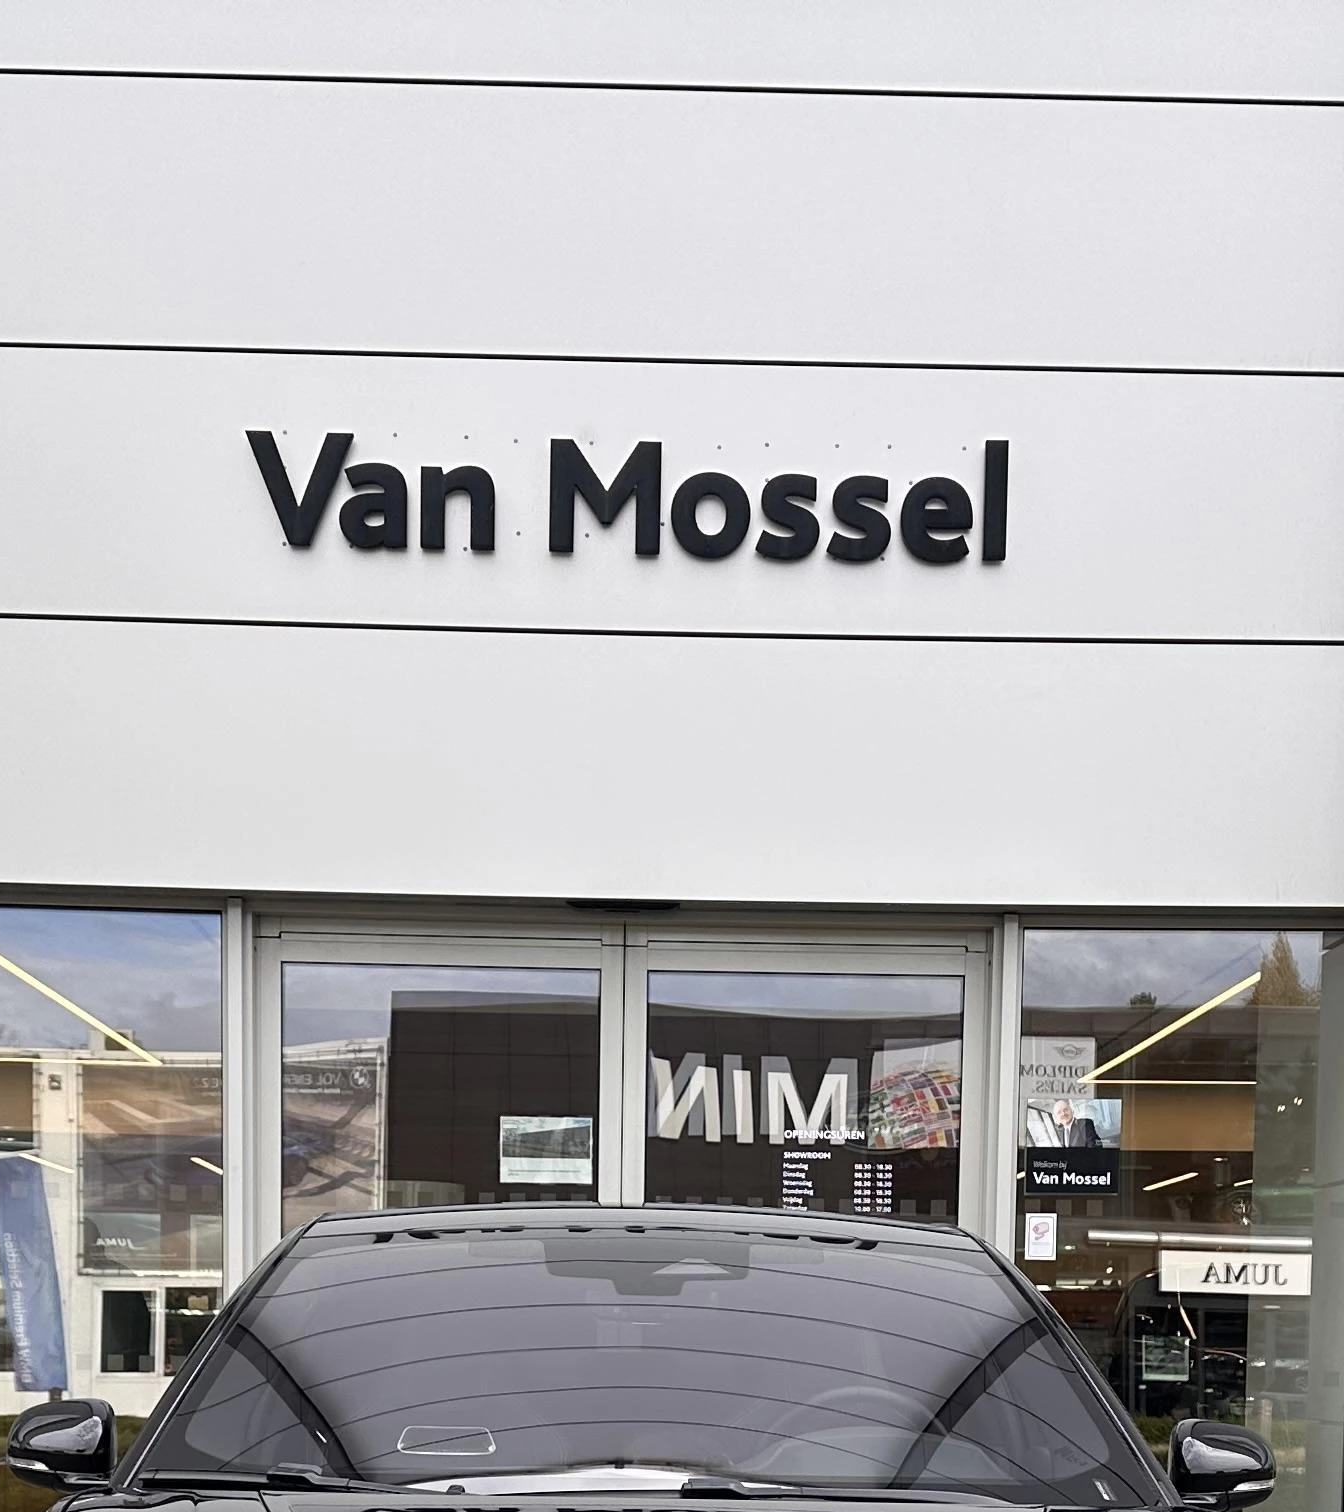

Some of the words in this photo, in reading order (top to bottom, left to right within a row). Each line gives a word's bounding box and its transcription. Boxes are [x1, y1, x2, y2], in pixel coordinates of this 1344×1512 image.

[244, 430, 497, 551] Van
[549, 438, 1010, 563] Mossel
[784, 1129, 865, 1140] OPENINGSUREN
[1033, 1171, 1058, 1184] Van
[1062, 1171, 1111, 1185] Mossel
